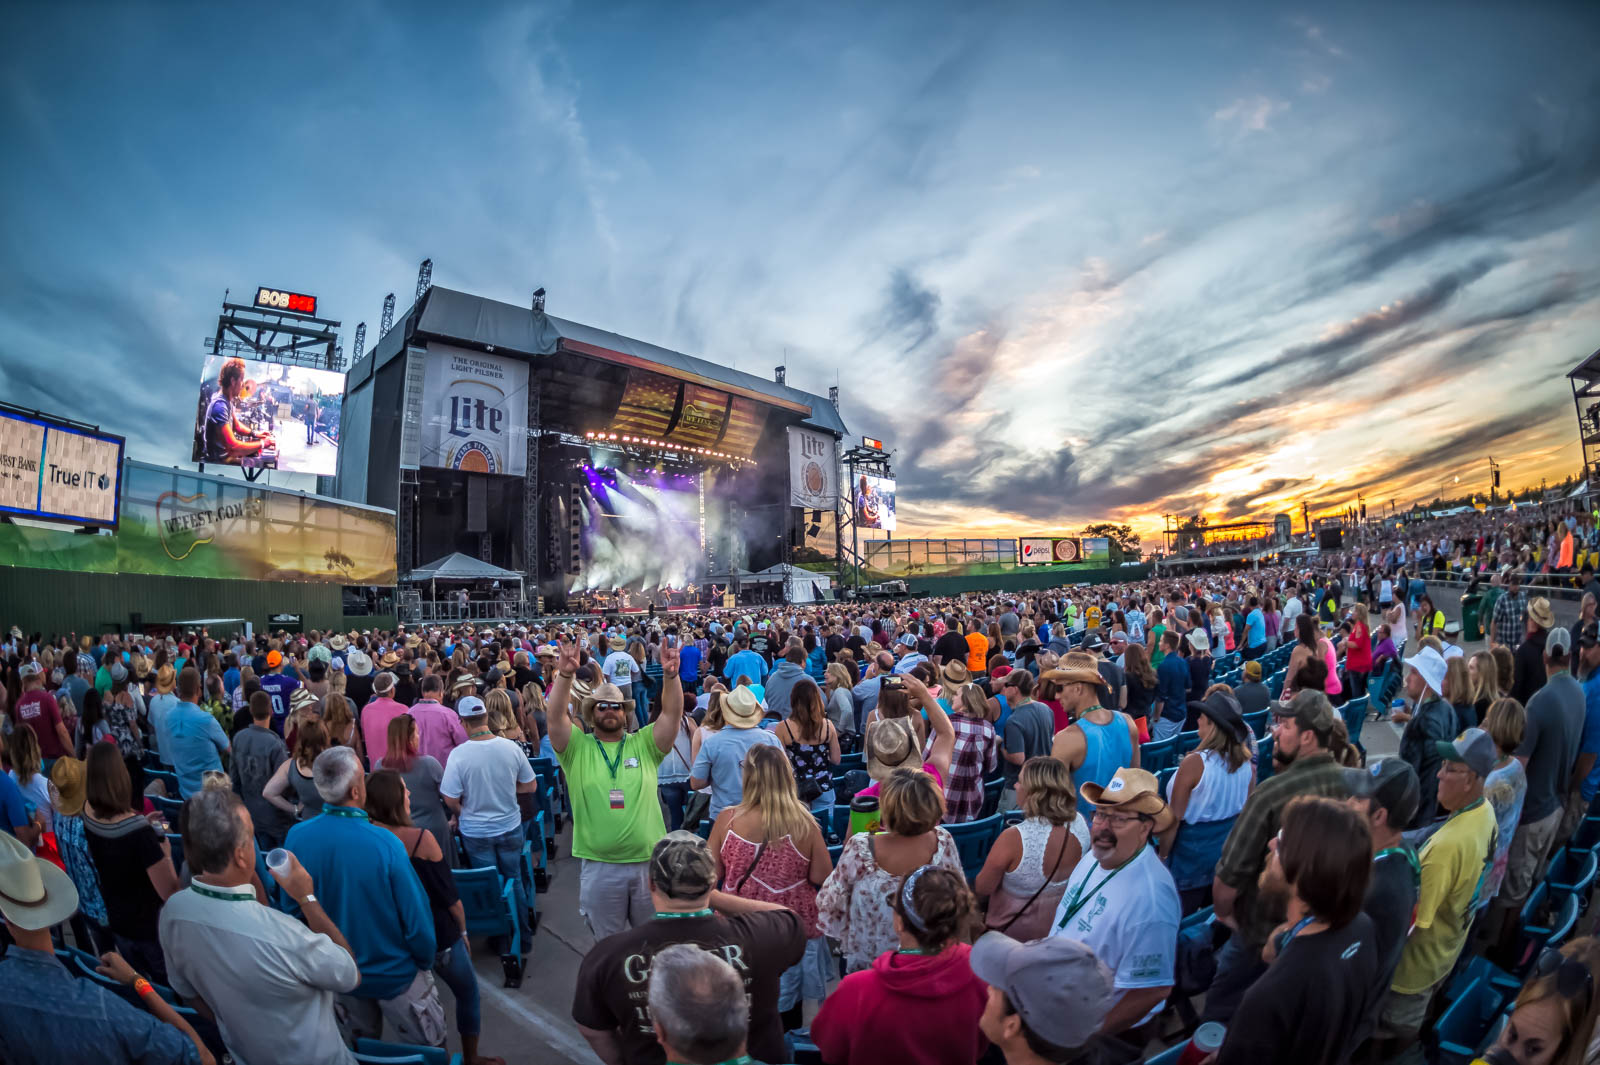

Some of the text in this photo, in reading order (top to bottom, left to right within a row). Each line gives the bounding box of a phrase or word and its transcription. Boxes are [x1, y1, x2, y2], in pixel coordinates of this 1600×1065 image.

[259, 289, 290, 308] BOB
[451, 364, 473, 374] LIGHT
[453, 356, 503, 371] THE ORIGINAL
[448, 396, 503, 438] Lite
[800, 432, 825, 460] Lite
[49, 463, 97, 489] True IT
[164, 503, 243, 534] WEFEST.COM
